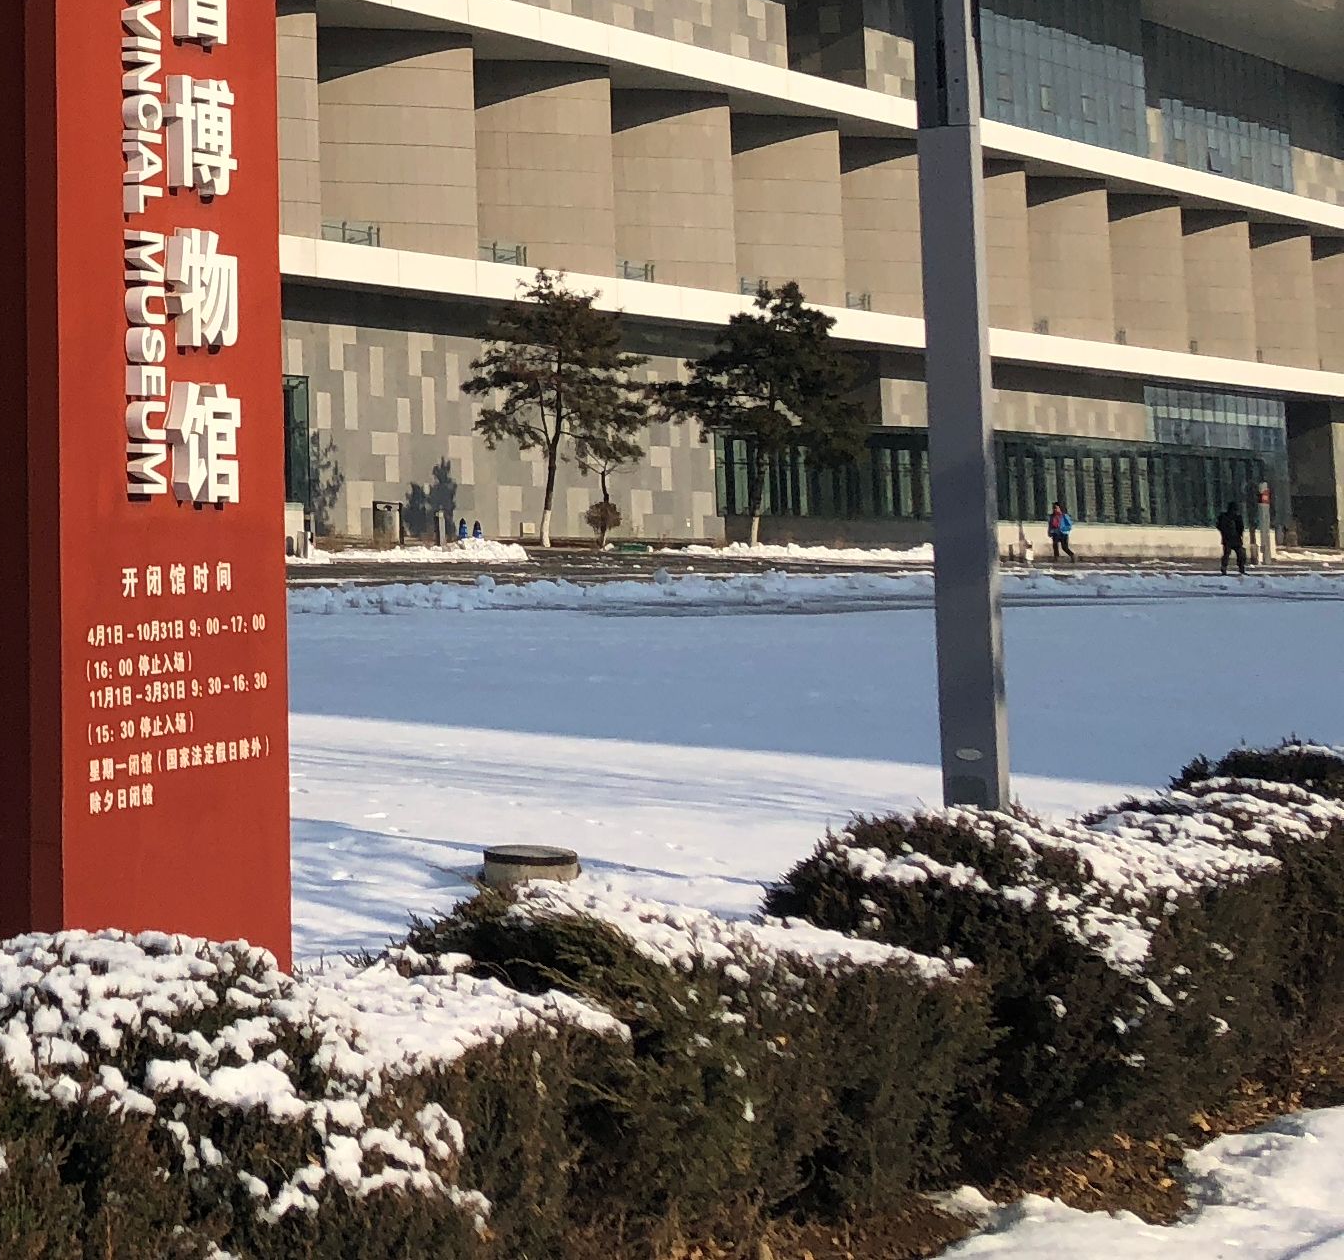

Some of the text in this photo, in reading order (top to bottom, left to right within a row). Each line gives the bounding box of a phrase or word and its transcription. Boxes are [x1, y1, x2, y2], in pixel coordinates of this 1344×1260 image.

[123, 228, 167, 497] MUSEUM
[121, 561, 232, 598] 开闭馆时间
[88, 782, 154, 815] 除夕日闭馆
